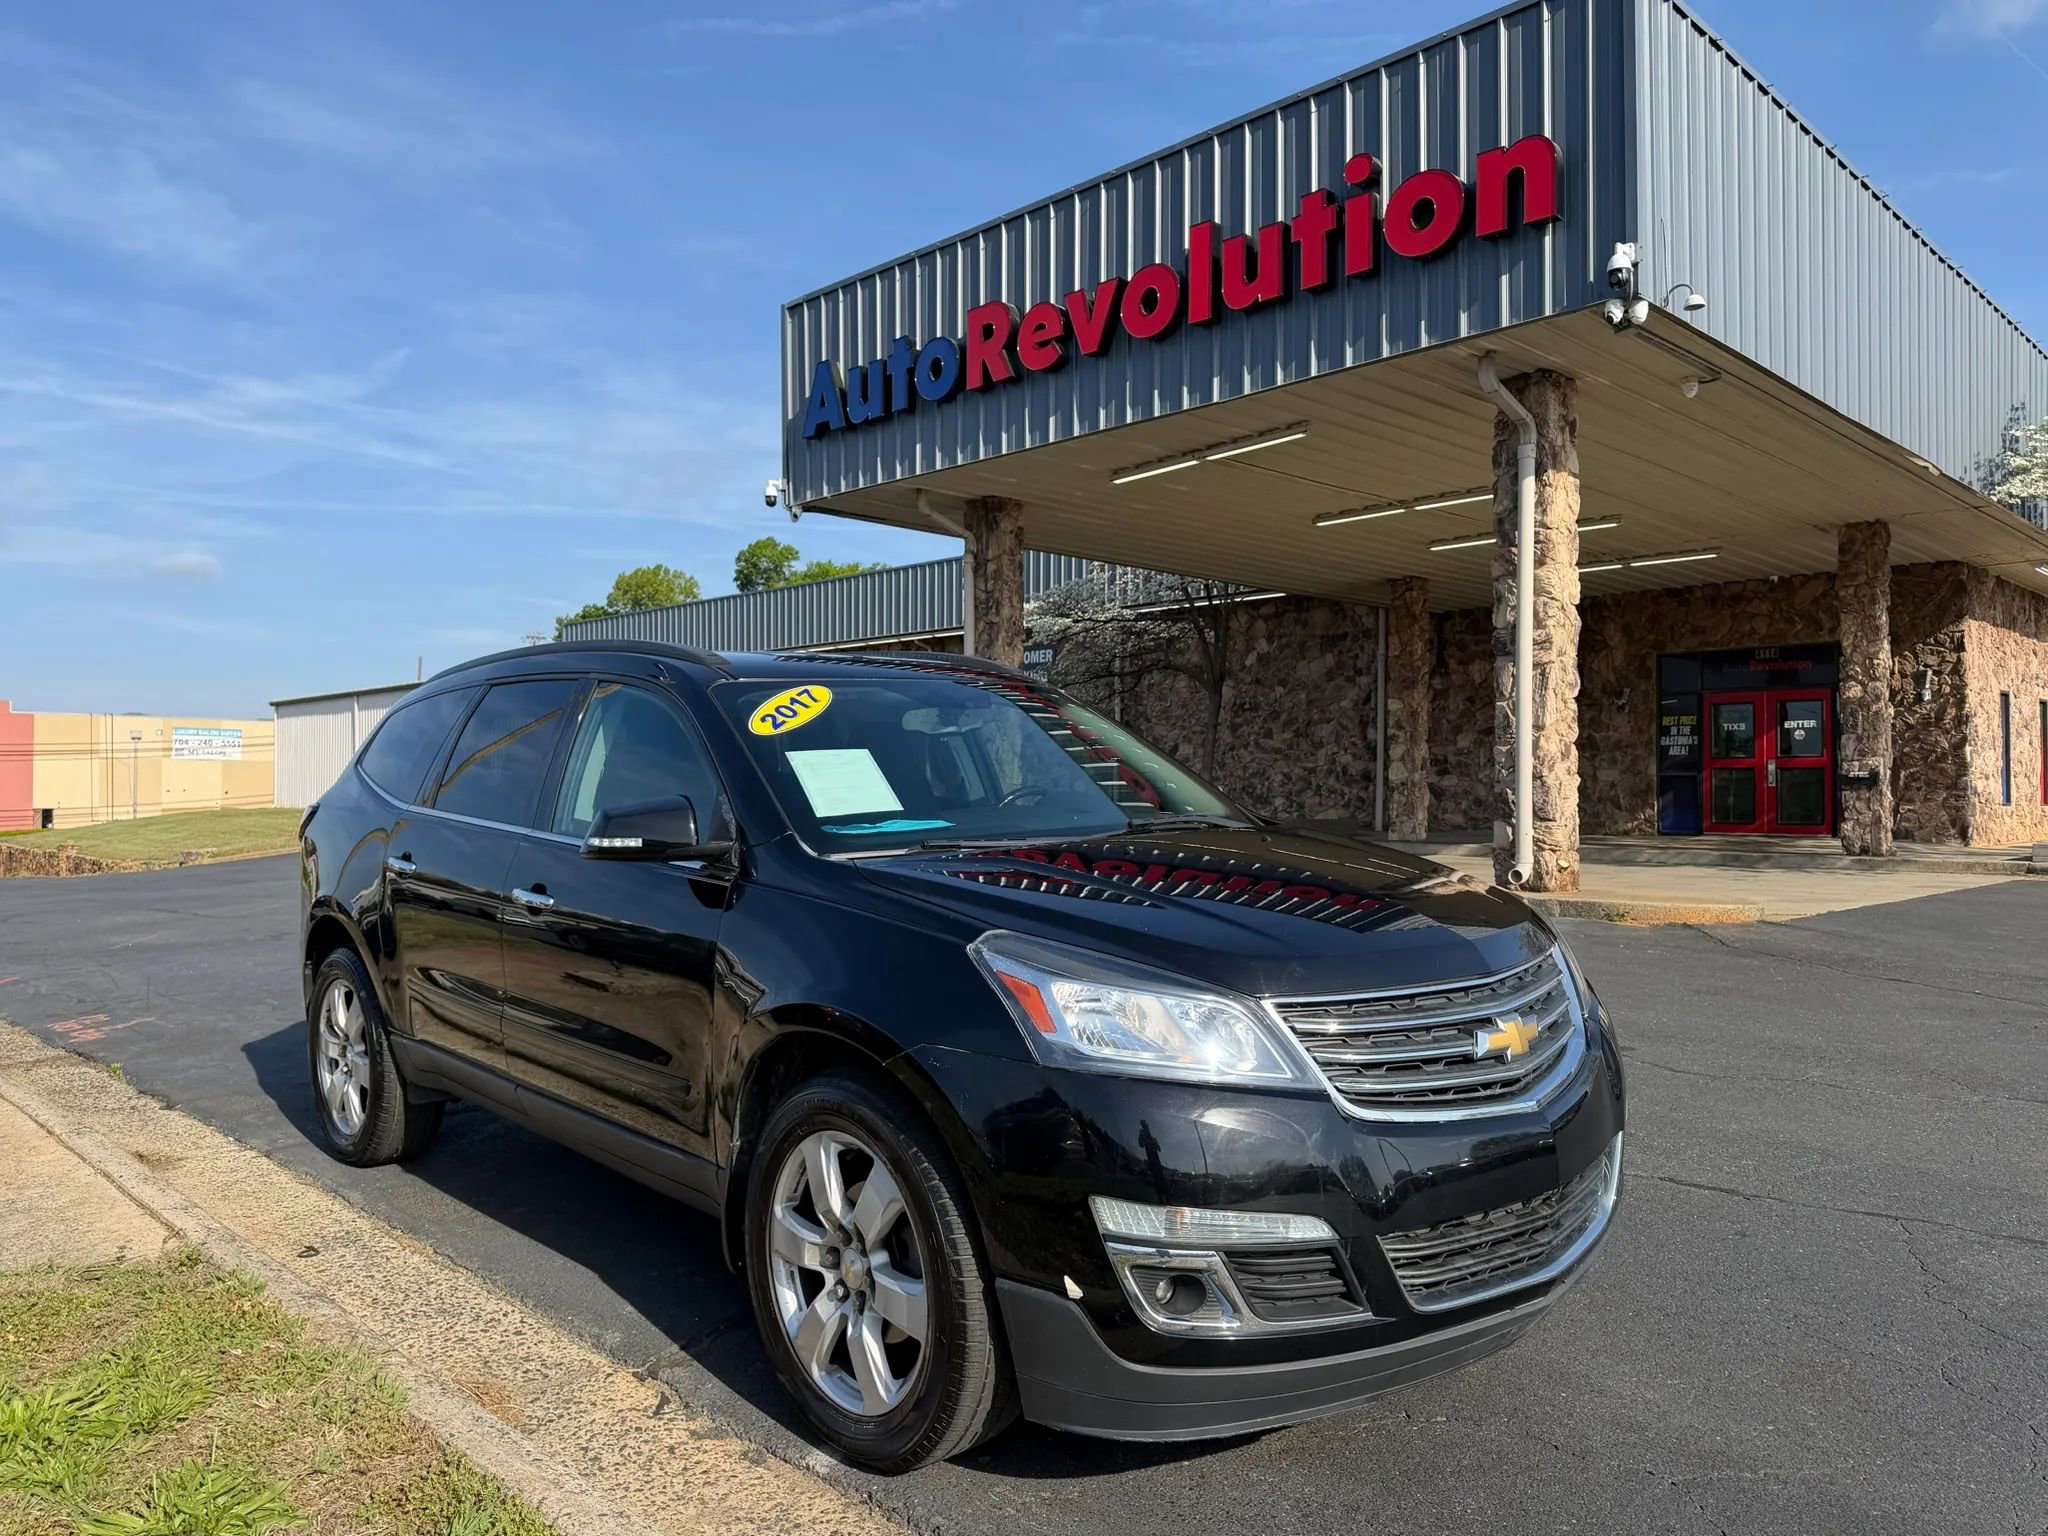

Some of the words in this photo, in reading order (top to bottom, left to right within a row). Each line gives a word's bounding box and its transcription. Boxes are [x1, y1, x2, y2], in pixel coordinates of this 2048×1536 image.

[802, 134, 1562, 440] AutoRevolution
[760, 688, 821, 730] 2017
[1662, 715, 1679, 726] BEST
[1784, 720, 1817, 729] ENTER
[1670, 726, 1678, 735] IN
[1679, 725, 1691, 735] THE
[1668, 745, 1689, 755] AREA!
